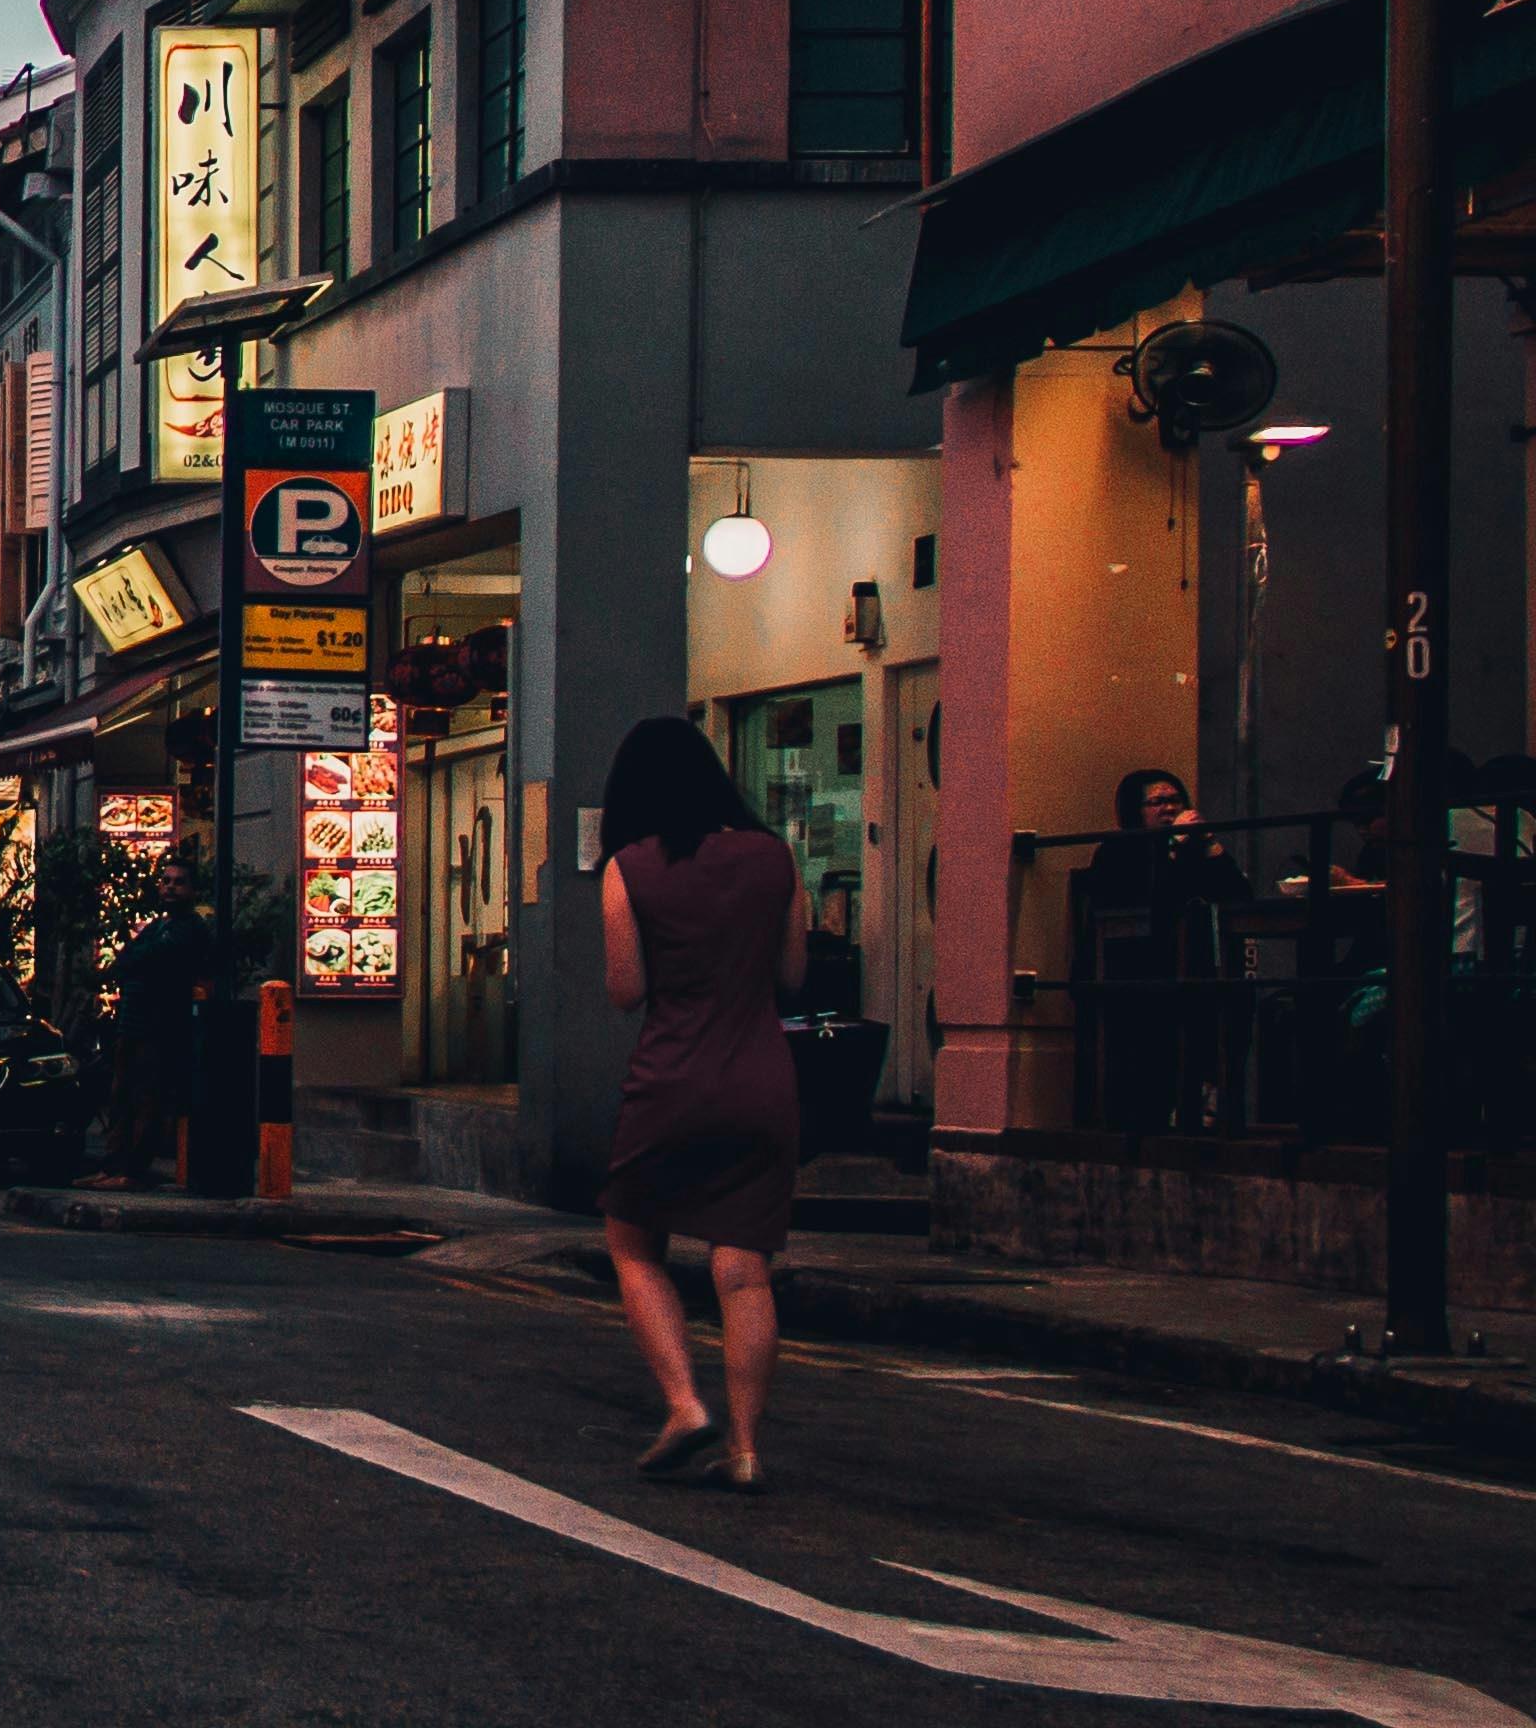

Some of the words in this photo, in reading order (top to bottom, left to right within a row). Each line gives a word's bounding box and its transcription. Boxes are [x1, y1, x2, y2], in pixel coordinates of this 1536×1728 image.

[264, 401, 325, 415] MOSQUE
[332, 402, 353, 416] ST.
[270, 419, 299, 431] CAR
[306, 419, 344, 432] PARK
[378, 480, 413, 519] BBQ
[278, 489, 349, 553] P
[270, 608, 290, 620] Day
[317, 630, 364, 648] $1.20
[331, 707, 362, 725] 60¢
